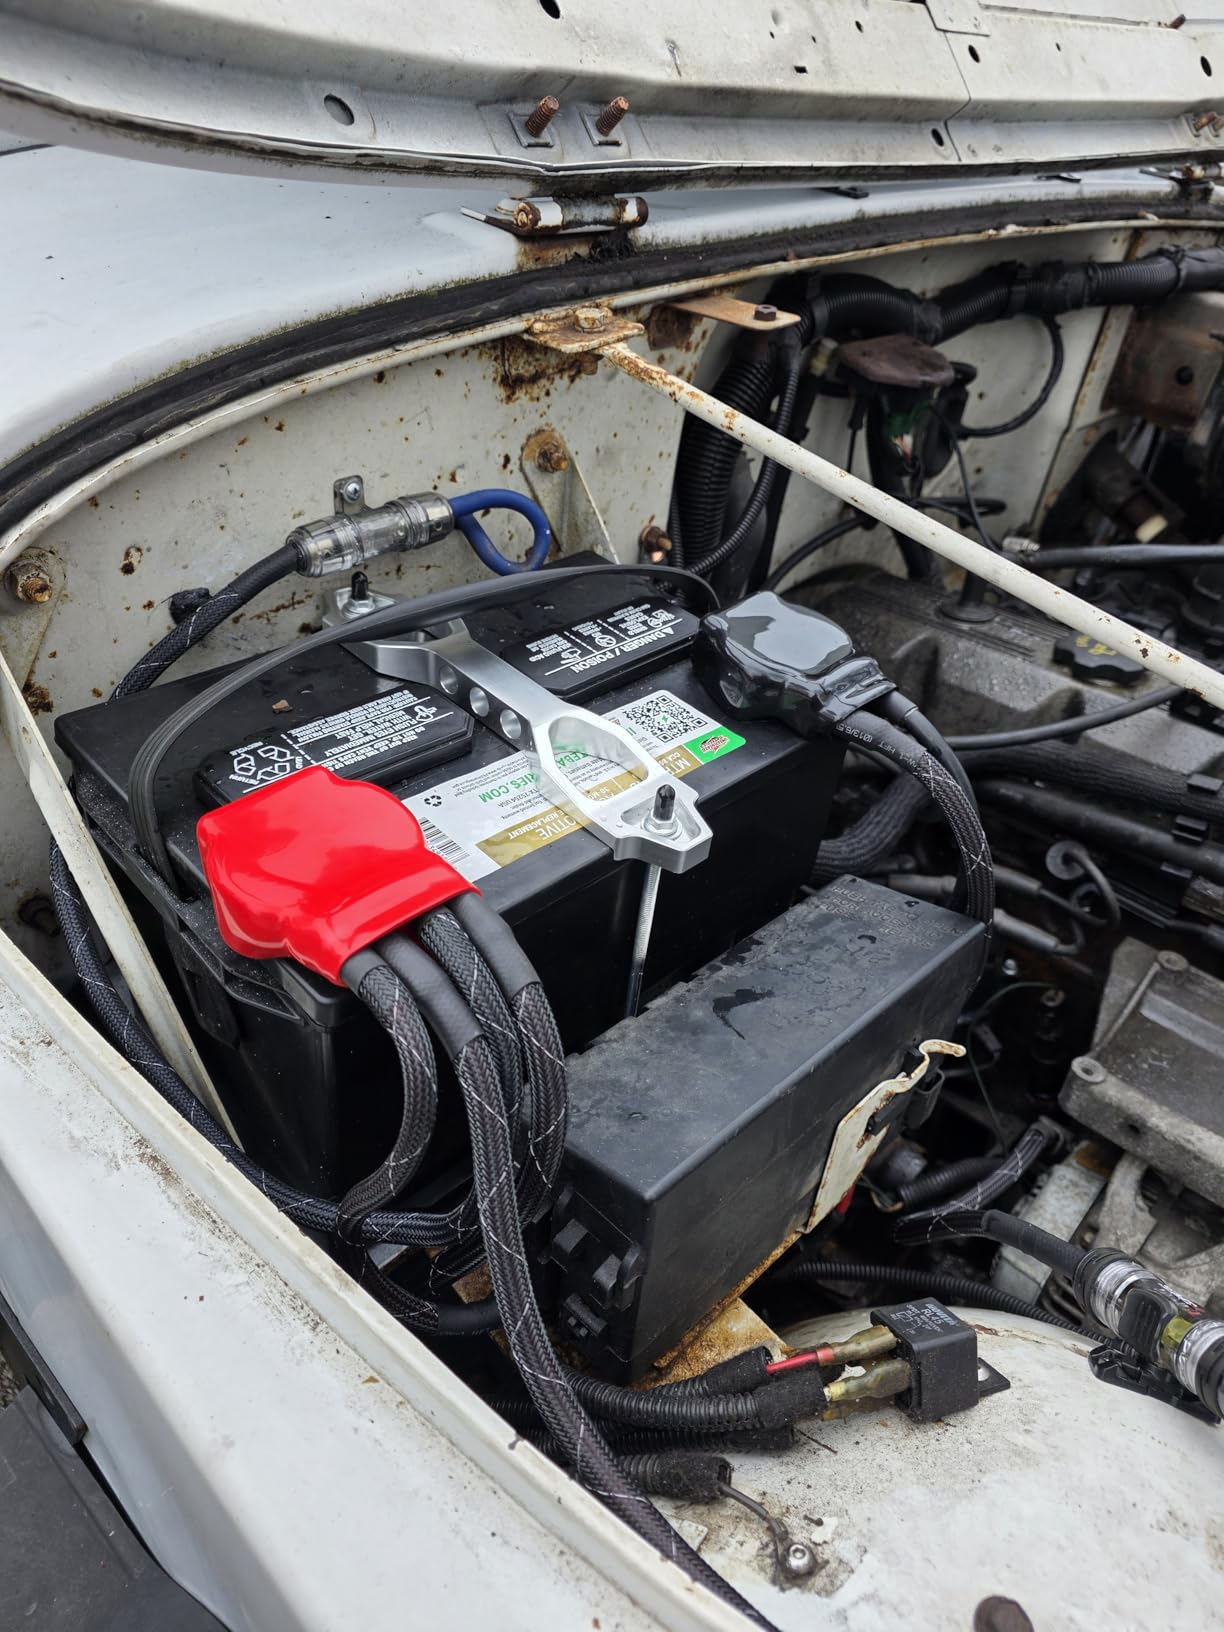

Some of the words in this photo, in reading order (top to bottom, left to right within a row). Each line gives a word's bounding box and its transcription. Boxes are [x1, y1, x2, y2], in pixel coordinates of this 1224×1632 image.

[618, 630, 666, 653] DANGER
[568, 650, 616, 673] POISON
[371, 708, 406, 725] MEDICAL
[388, 713, 412, 724] WITH
[390, 717, 418, 731] FLUSH
[332, 727, 355, 739] FAST
[351, 720, 375, 732] HELP
[372, 726, 395, 738] EYES
[345, 730, 365, 741] GET
[227, 739, 264, 756] RECYCLE
[321, 733, 376, 757] IMMEDIATELY
[476, 770, 539, 803] RIES.COM
[504, 810, 561, 840] REPLACEMENT
[538, 813, 577, 841] OTIVE
[919, 1307, 945, 1324] RL45
